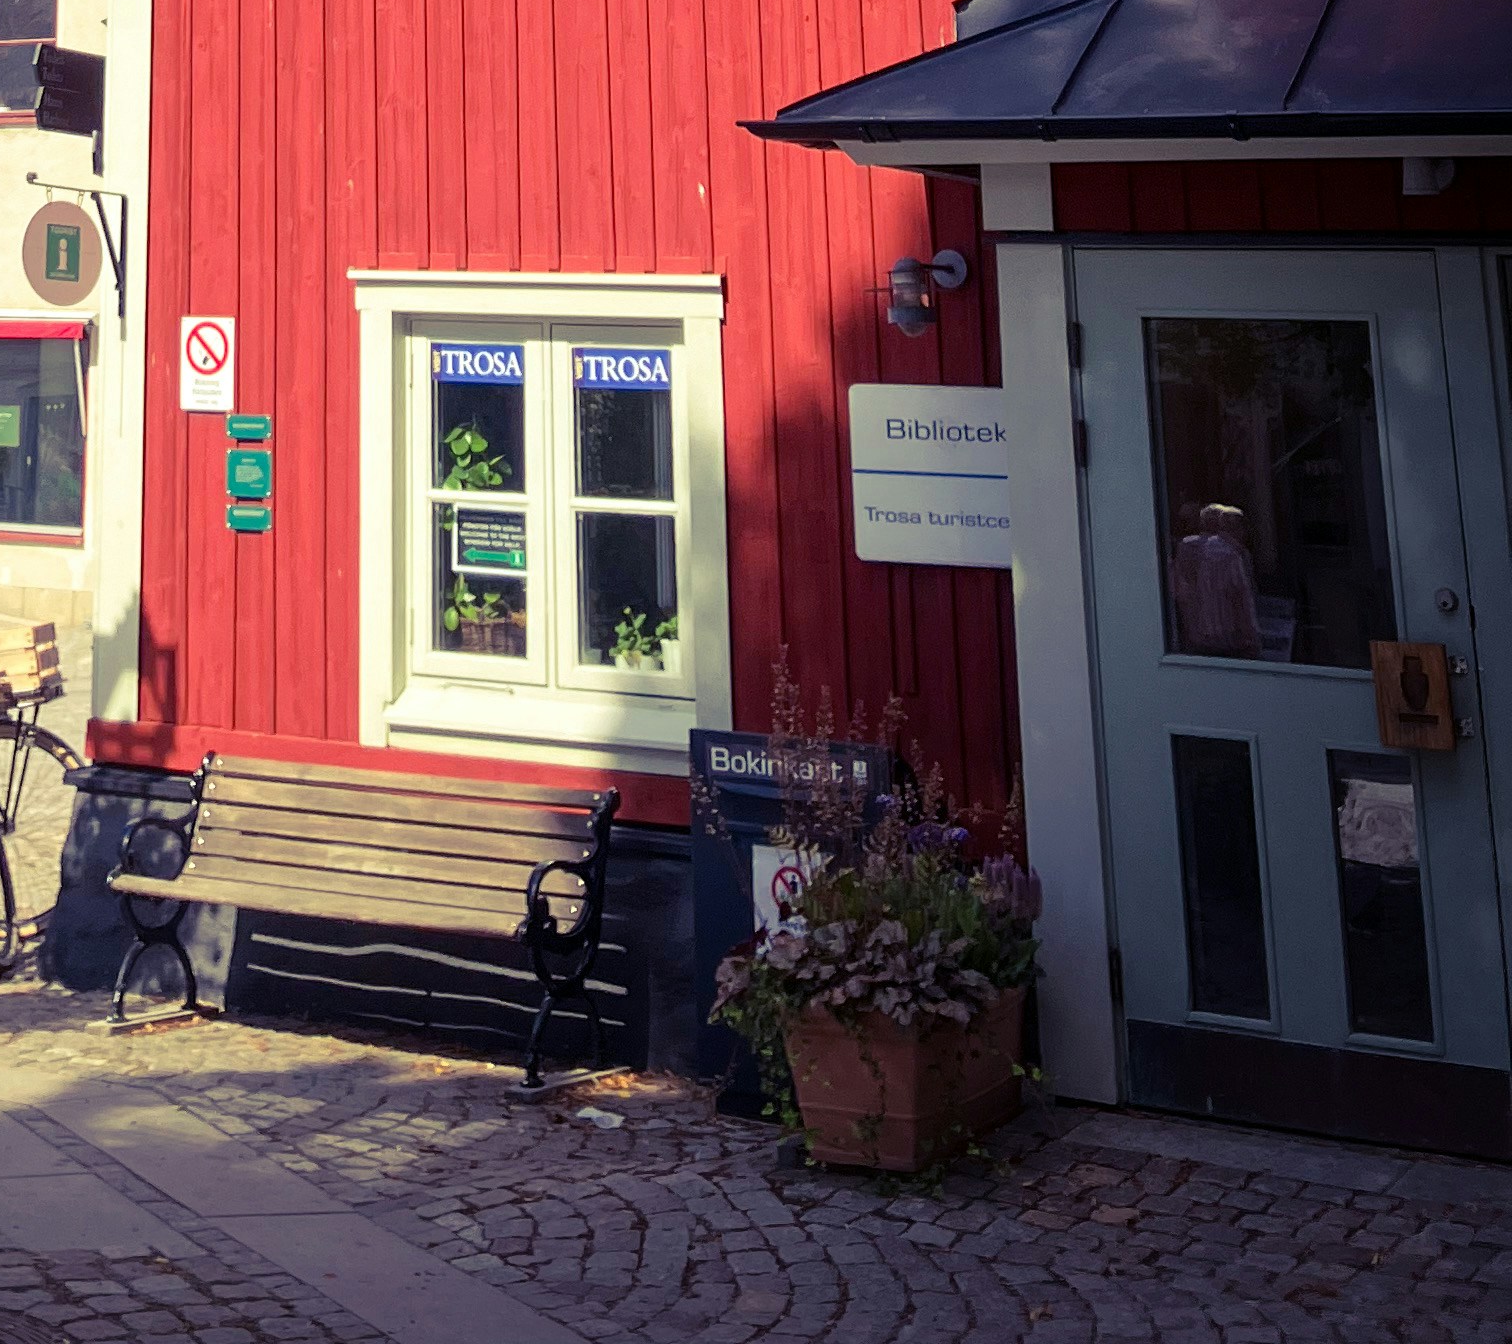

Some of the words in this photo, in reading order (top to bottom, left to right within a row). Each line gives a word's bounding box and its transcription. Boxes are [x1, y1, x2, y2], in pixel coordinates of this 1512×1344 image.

[442, 350, 522, 376] TROSA
[584, 356, 669, 382] TROSA
[886, 418, 1007, 443] Bibliotek
[864, 506, 921, 525] Trosa
[928, 511, 1011, 529] turistce
